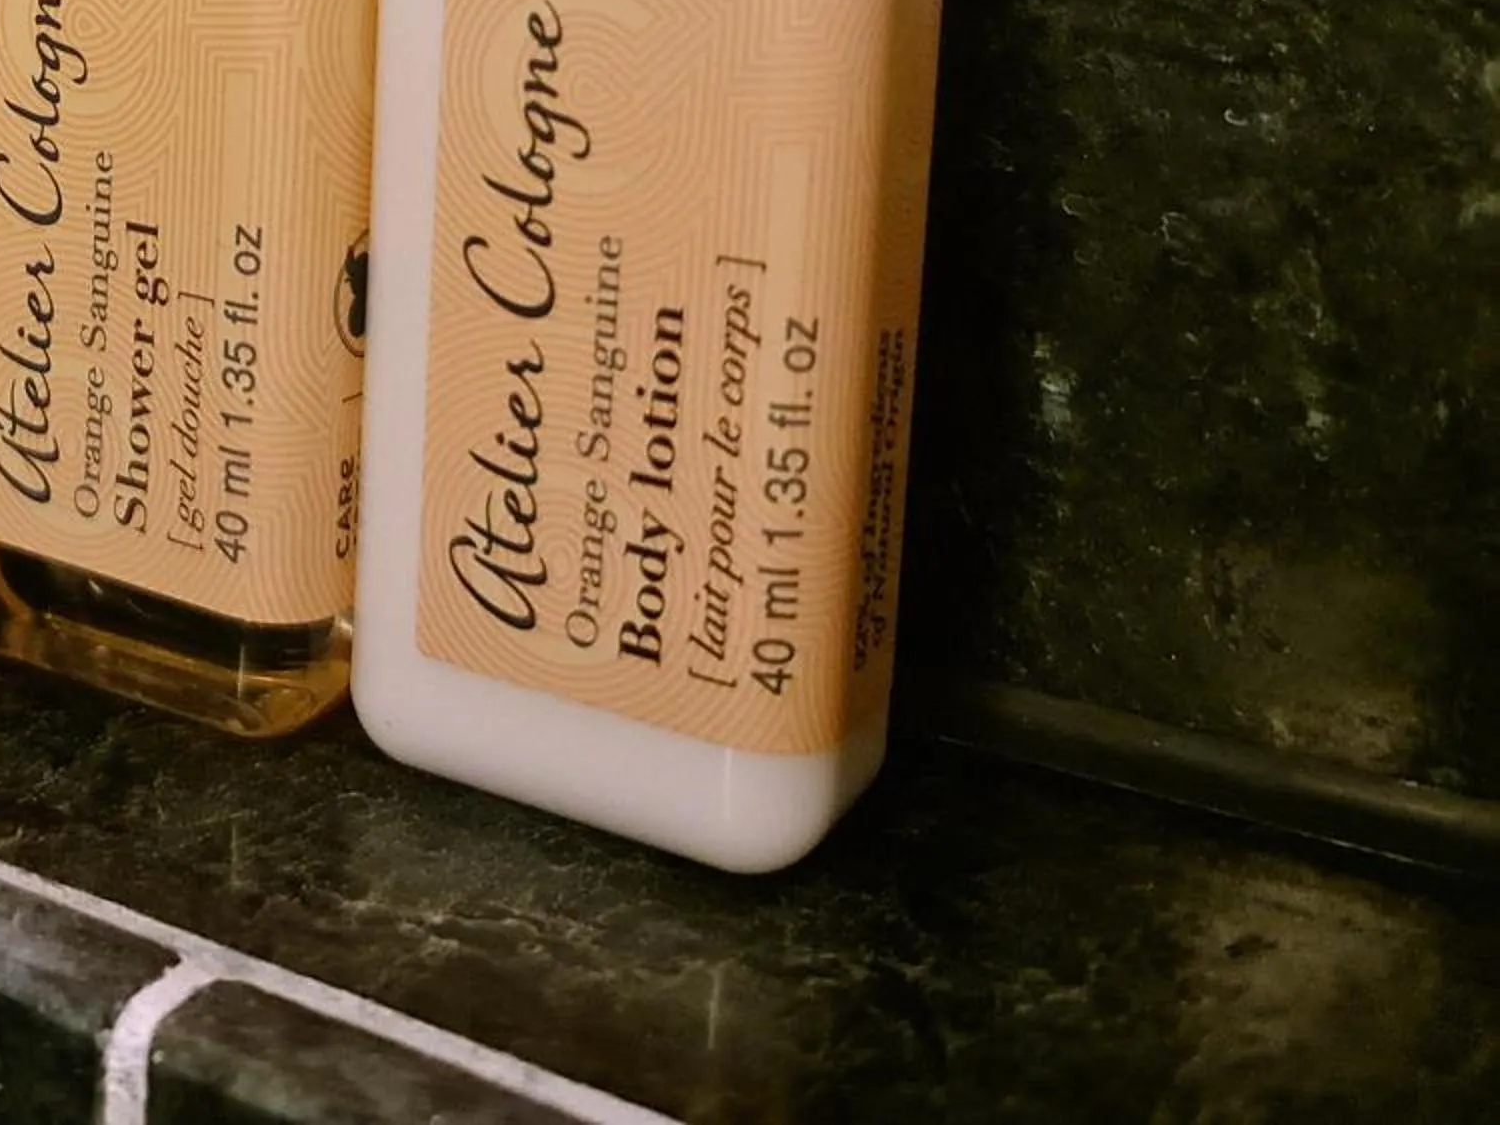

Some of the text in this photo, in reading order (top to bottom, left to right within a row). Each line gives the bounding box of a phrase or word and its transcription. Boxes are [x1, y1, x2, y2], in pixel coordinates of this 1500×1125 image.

[73, 150, 118, 518] Orange Sanguine
[113, 221, 169, 535] Shower gel
[214, 224, 263, 564] 40 ml 1.35 fl. oz
[448, 0, 591, 632] Atelier Cologne
[565, 234, 627, 649] Orange Sanguine
[618, 306, 685, 668] Body lotion
[702, 416, 742, 460] le
[705, 467, 743, 586] pour
[751, 317, 819, 697] 40 ml 1.35 fl. oz
